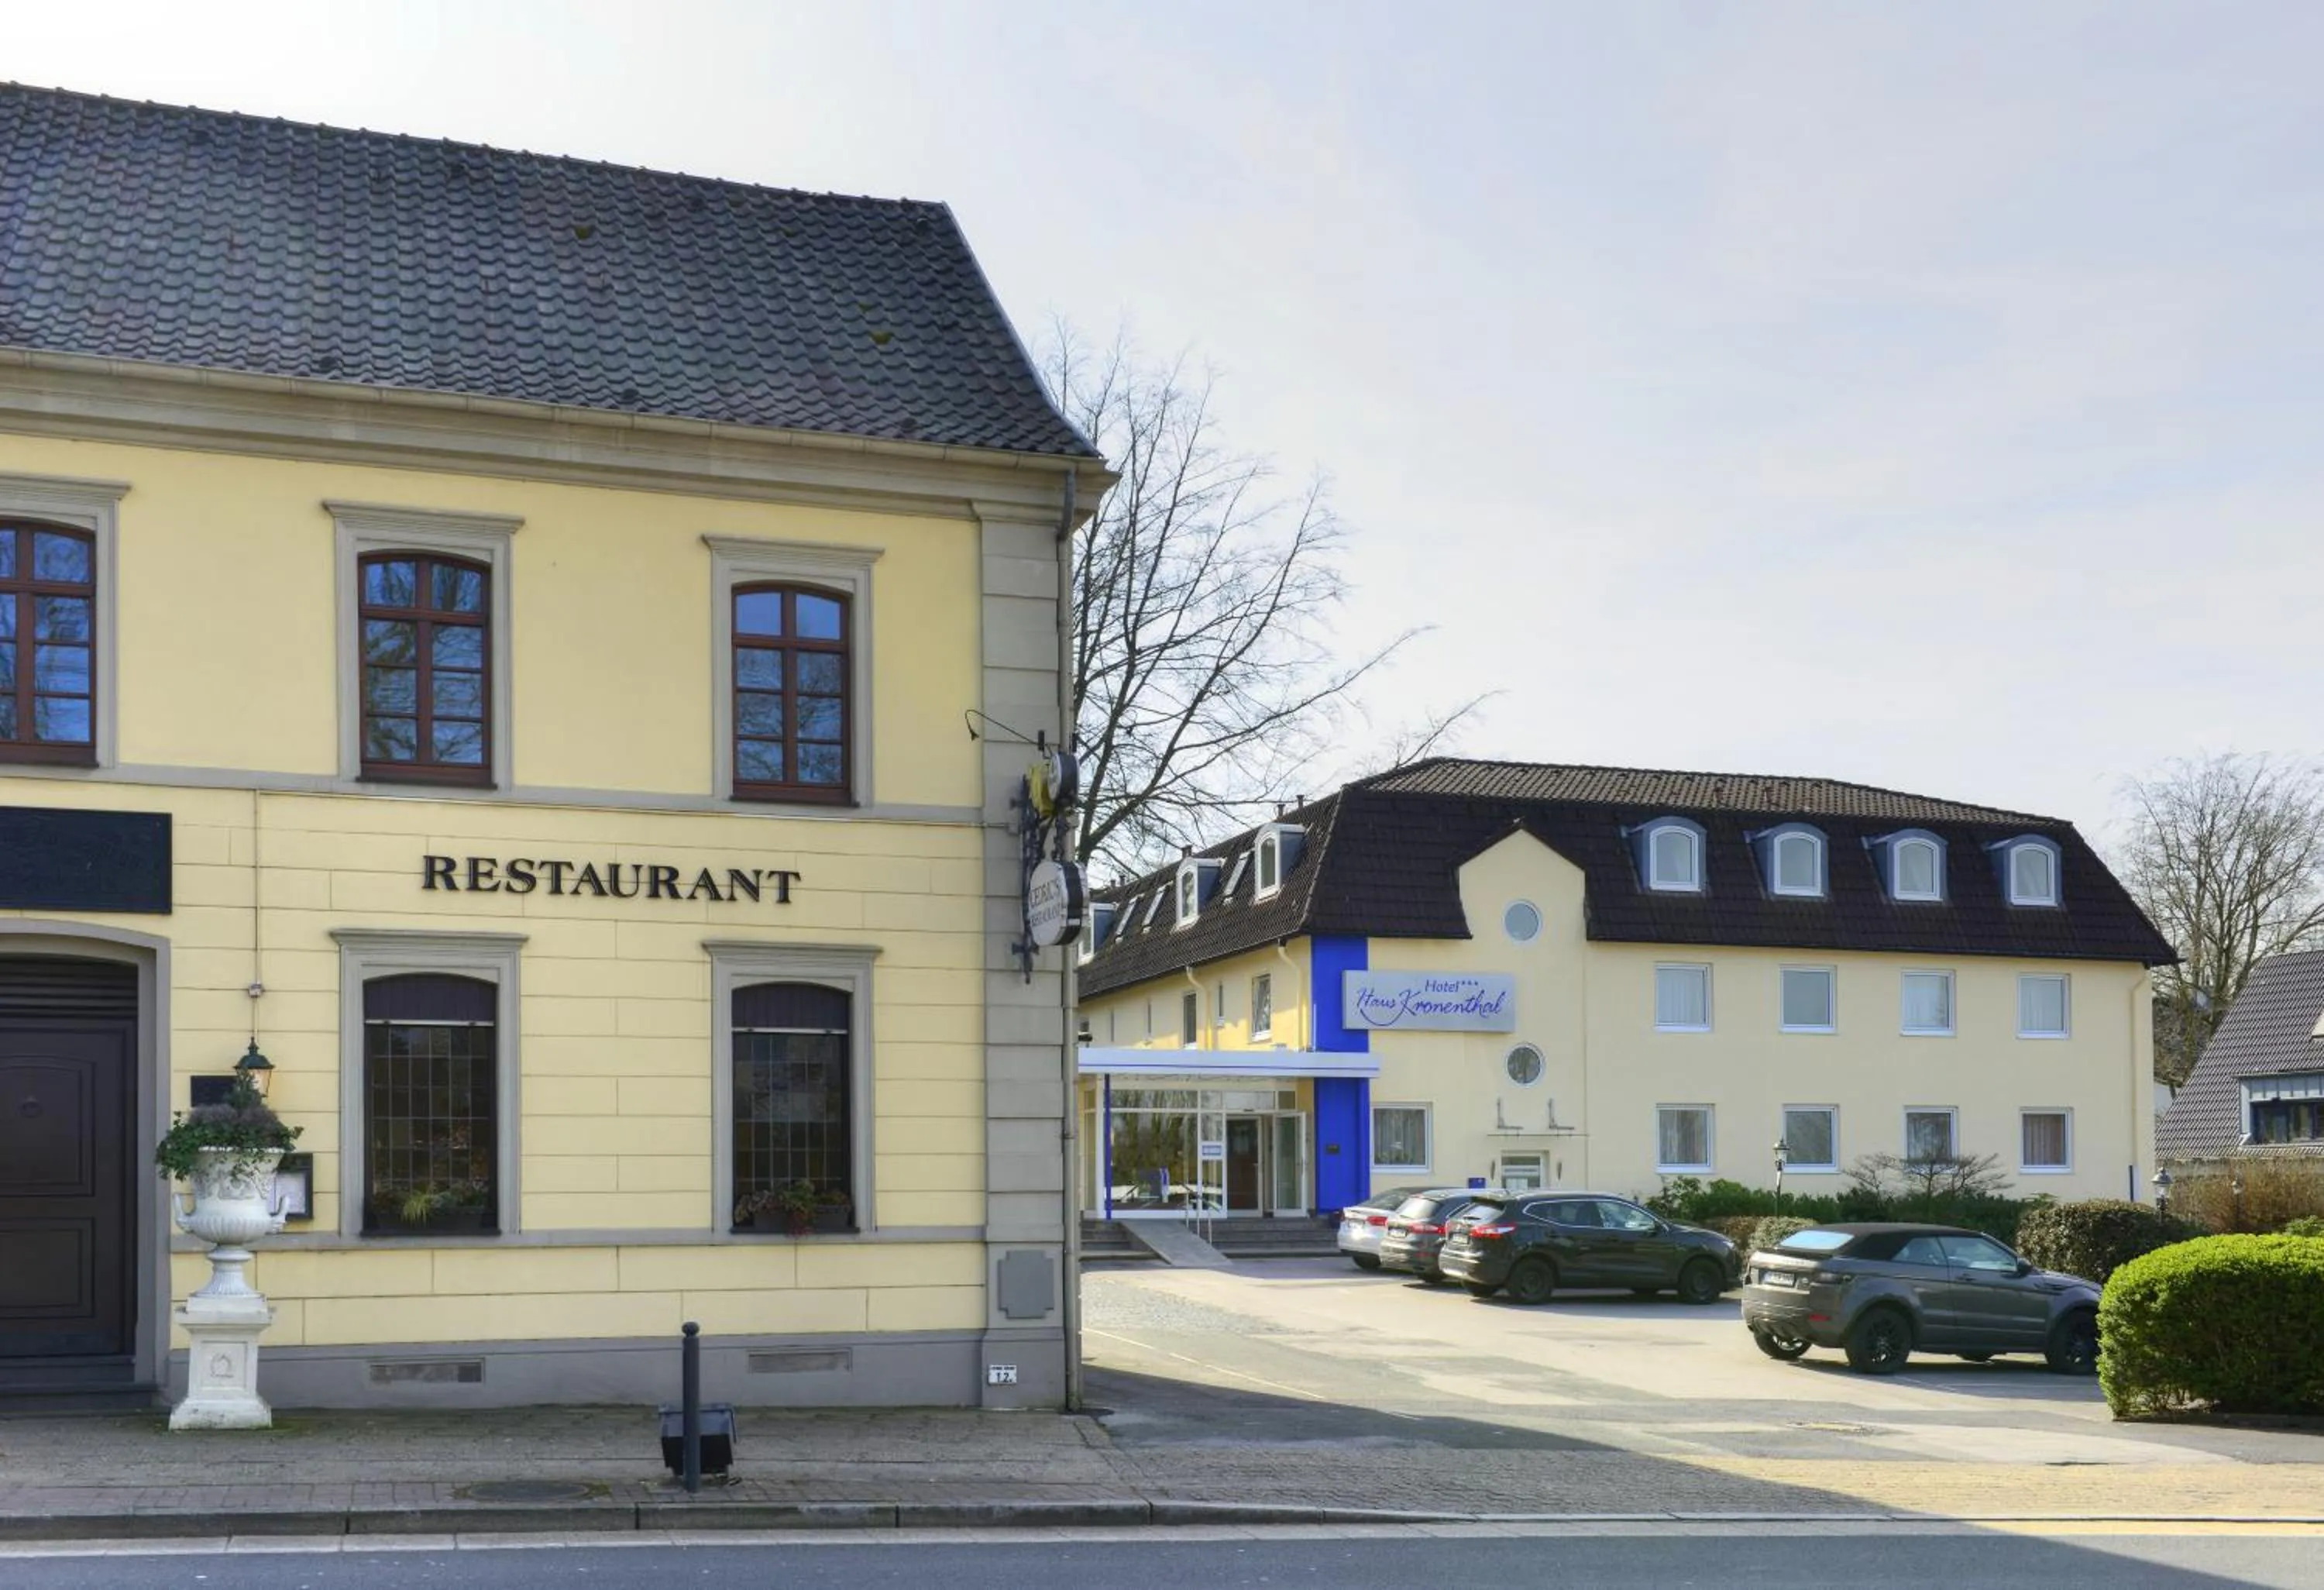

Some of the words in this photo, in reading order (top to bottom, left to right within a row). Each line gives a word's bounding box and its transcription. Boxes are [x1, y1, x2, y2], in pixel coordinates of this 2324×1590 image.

[422, 855, 802, 904] RESTAURANT
[1425, 979, 1459, 993] Hotel
[1356, 987, 1396, 1009] Haus
[1398, 989, 1507, 1018] Kronenthal
